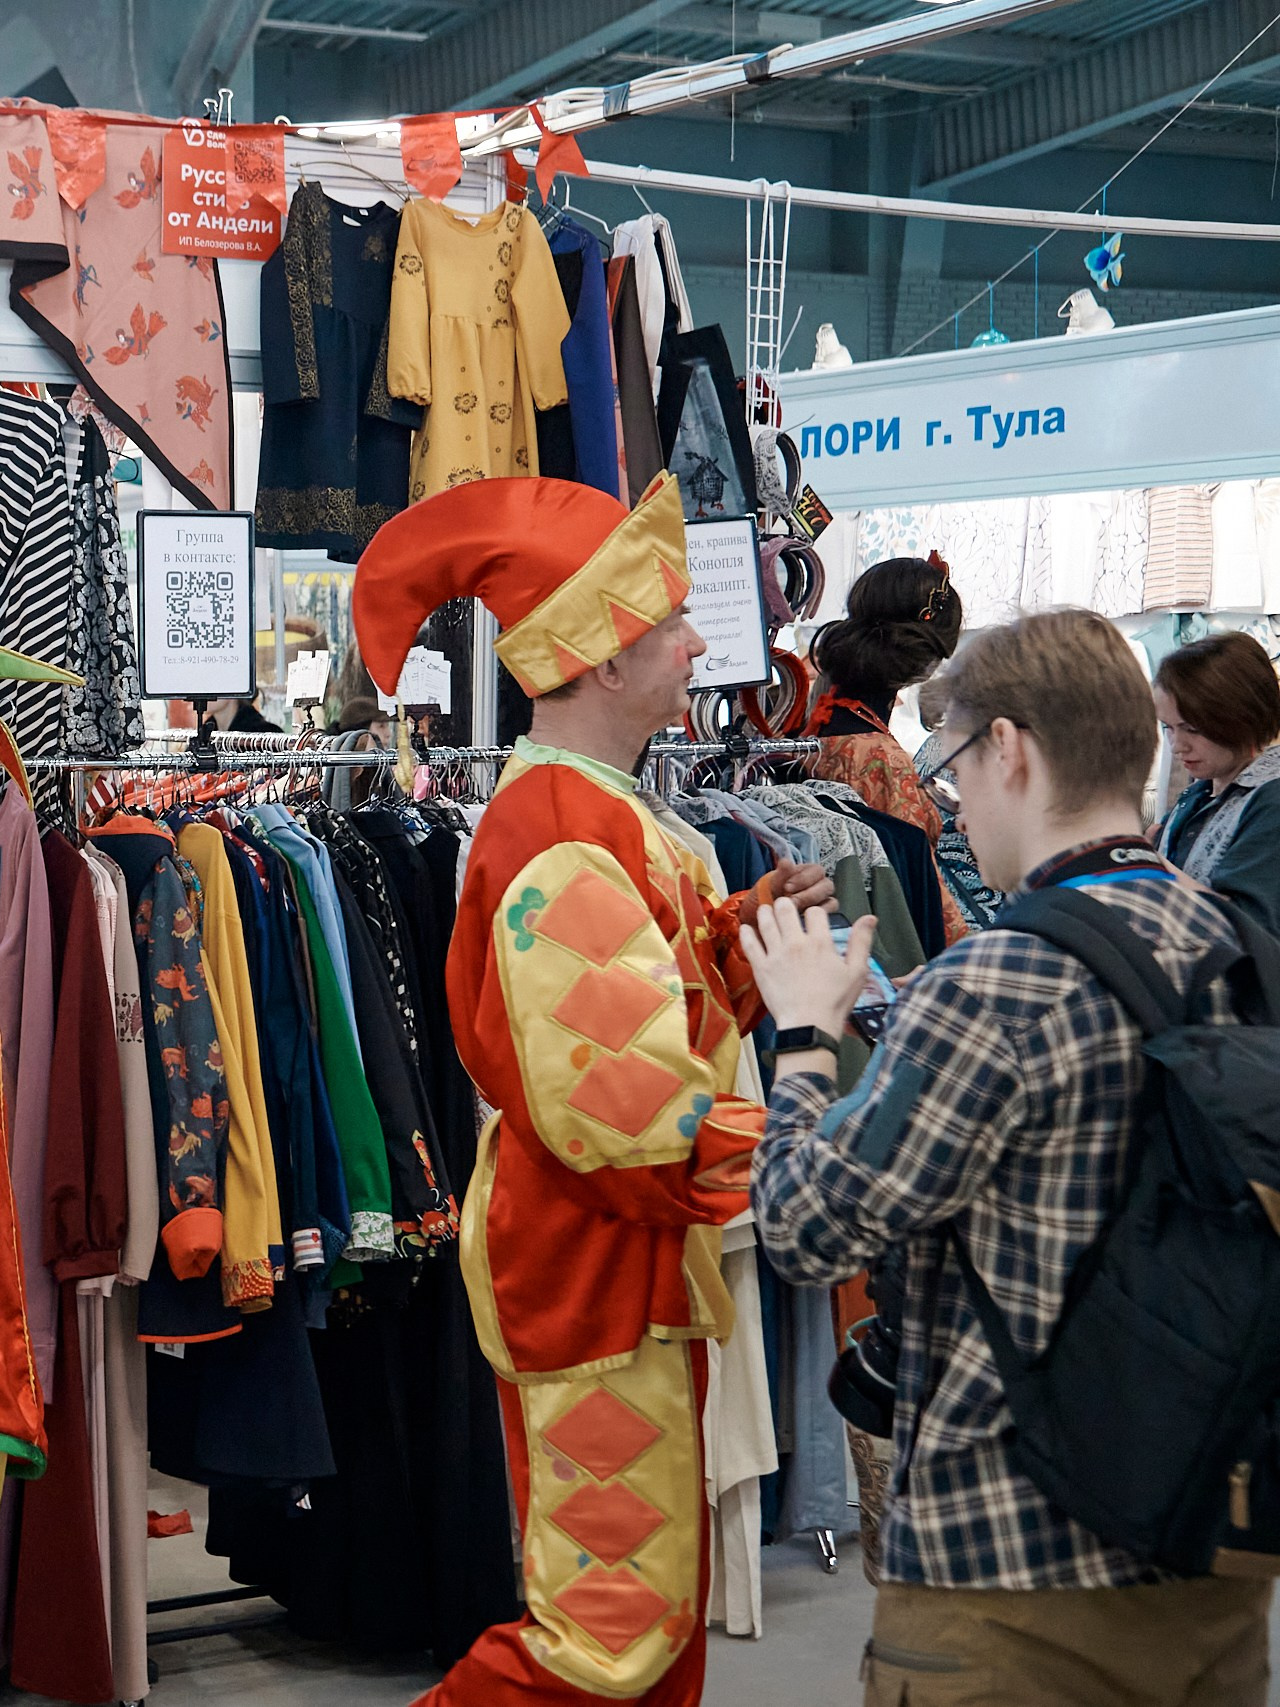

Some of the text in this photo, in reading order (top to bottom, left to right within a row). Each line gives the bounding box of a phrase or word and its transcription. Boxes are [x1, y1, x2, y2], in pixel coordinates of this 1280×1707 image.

[168, 211, 273, 235] от Андели
[179, 236, 262, 251] ИП Белозерова В.А.
[926, 420, 952, 446] г.
[966, 405, 1065, 449] Тула
[176, 529, 224, 546] Группа
[707, 536, 748, 550] крапива
[164, 553, 236, 564] в контакте:
[688, 556, 744, 572] Конопля
[698, 616, 740, 627] интересные
